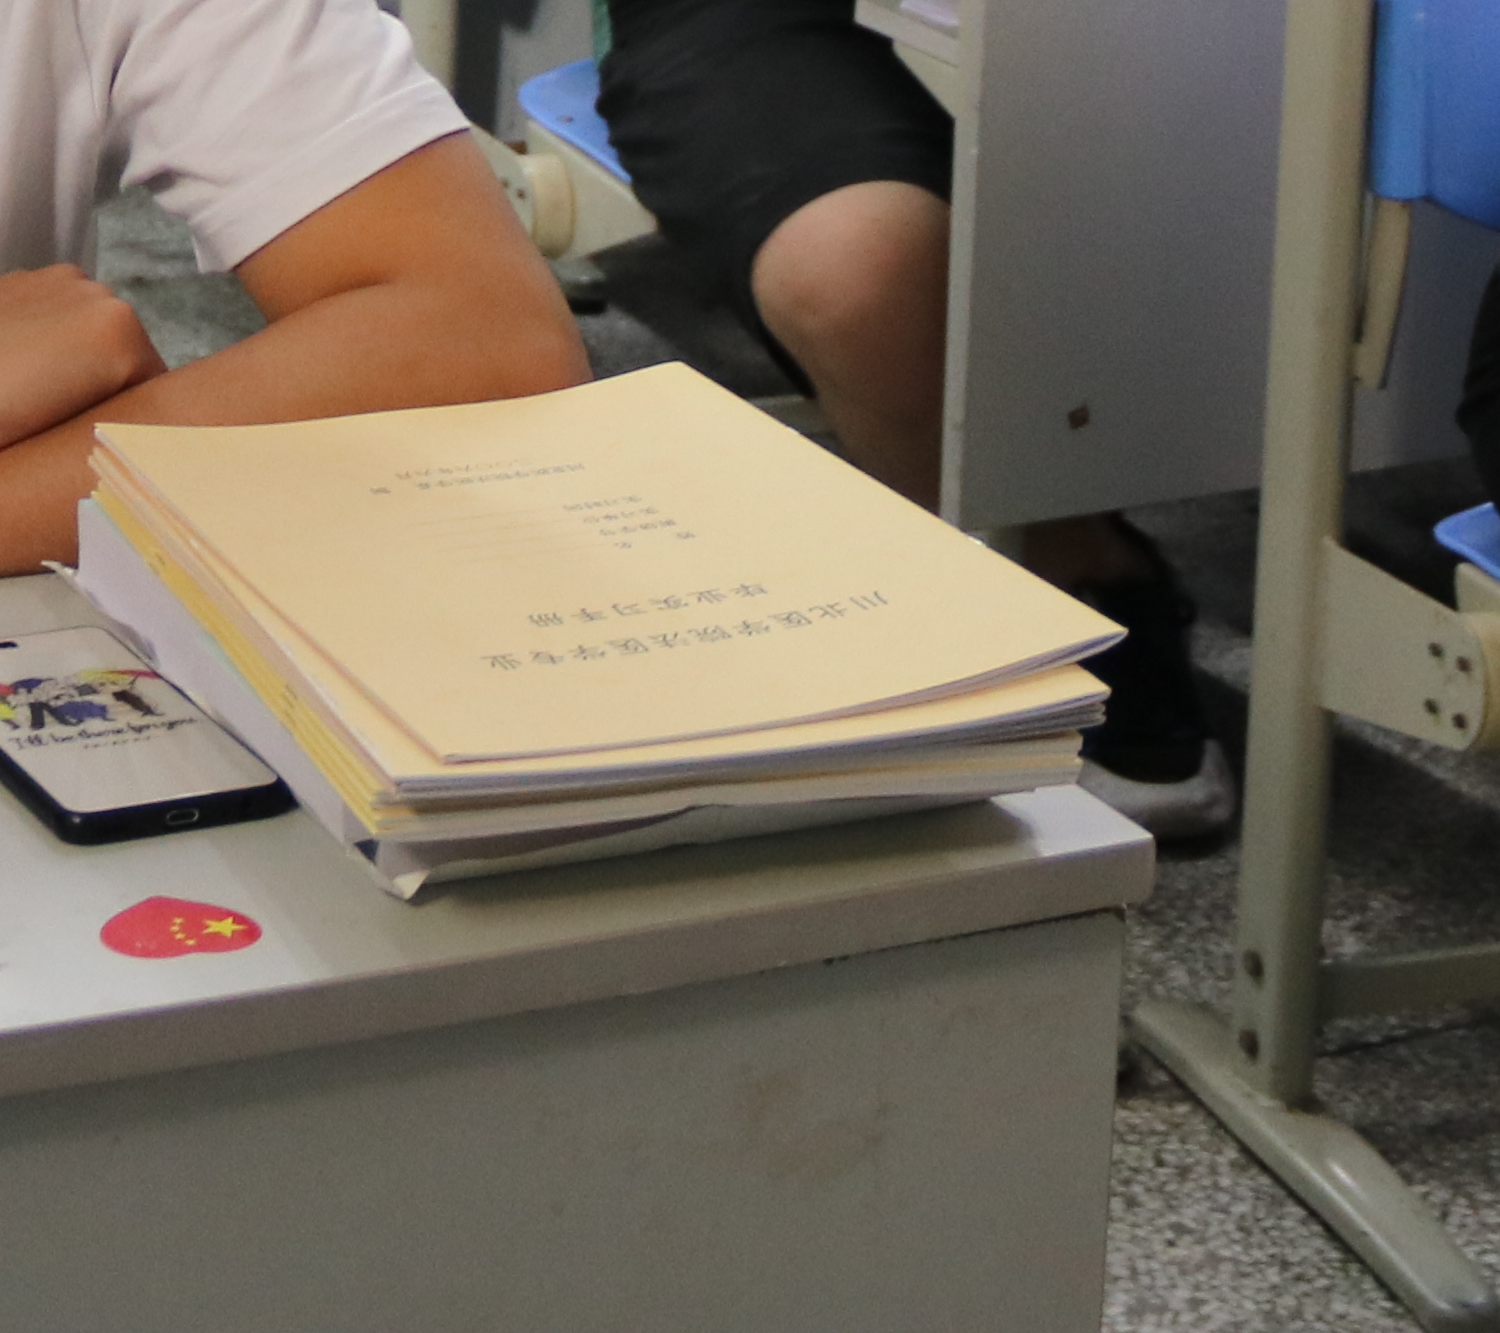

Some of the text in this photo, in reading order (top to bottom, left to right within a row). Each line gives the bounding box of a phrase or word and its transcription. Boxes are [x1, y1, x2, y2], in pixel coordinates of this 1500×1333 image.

[480, 589, 889, 672] 川北医学院法医学专业
[527, 582, 769, 629] 毕业实习手册
